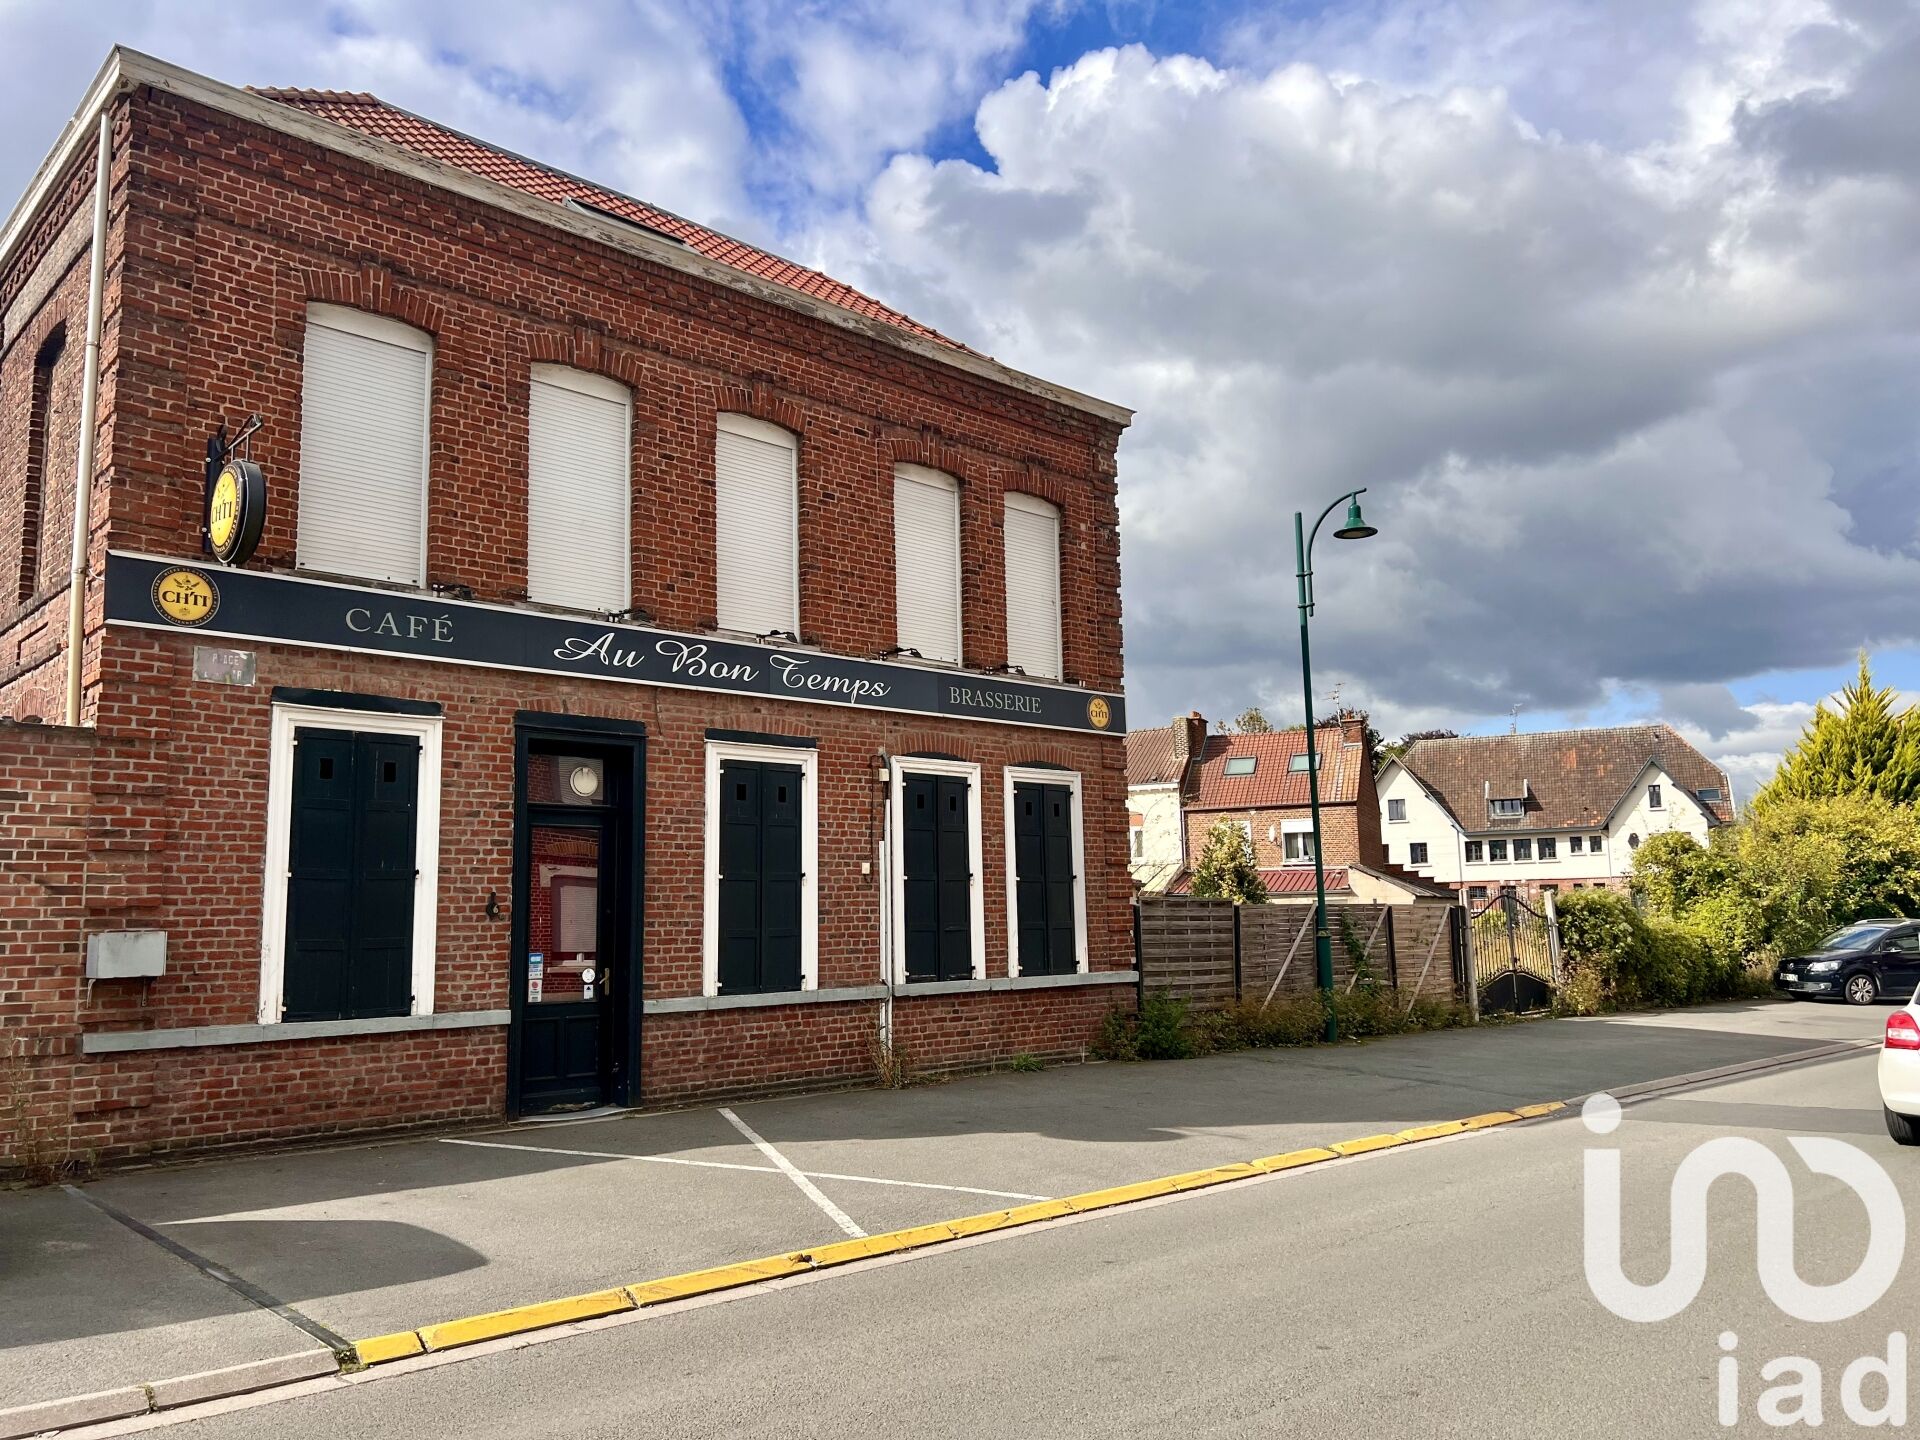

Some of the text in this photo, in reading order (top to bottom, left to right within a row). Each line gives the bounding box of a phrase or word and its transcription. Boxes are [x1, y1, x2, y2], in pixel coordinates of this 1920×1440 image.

[162, 590, 208, 607] CH'TI
[345, 607, 454, 642] CAFÉ
[212, 653, 240, 666] PACE
[553, 632, 891, 704] Au Bon Temps
[949, 686, 1042, 714] BRASSERIE
